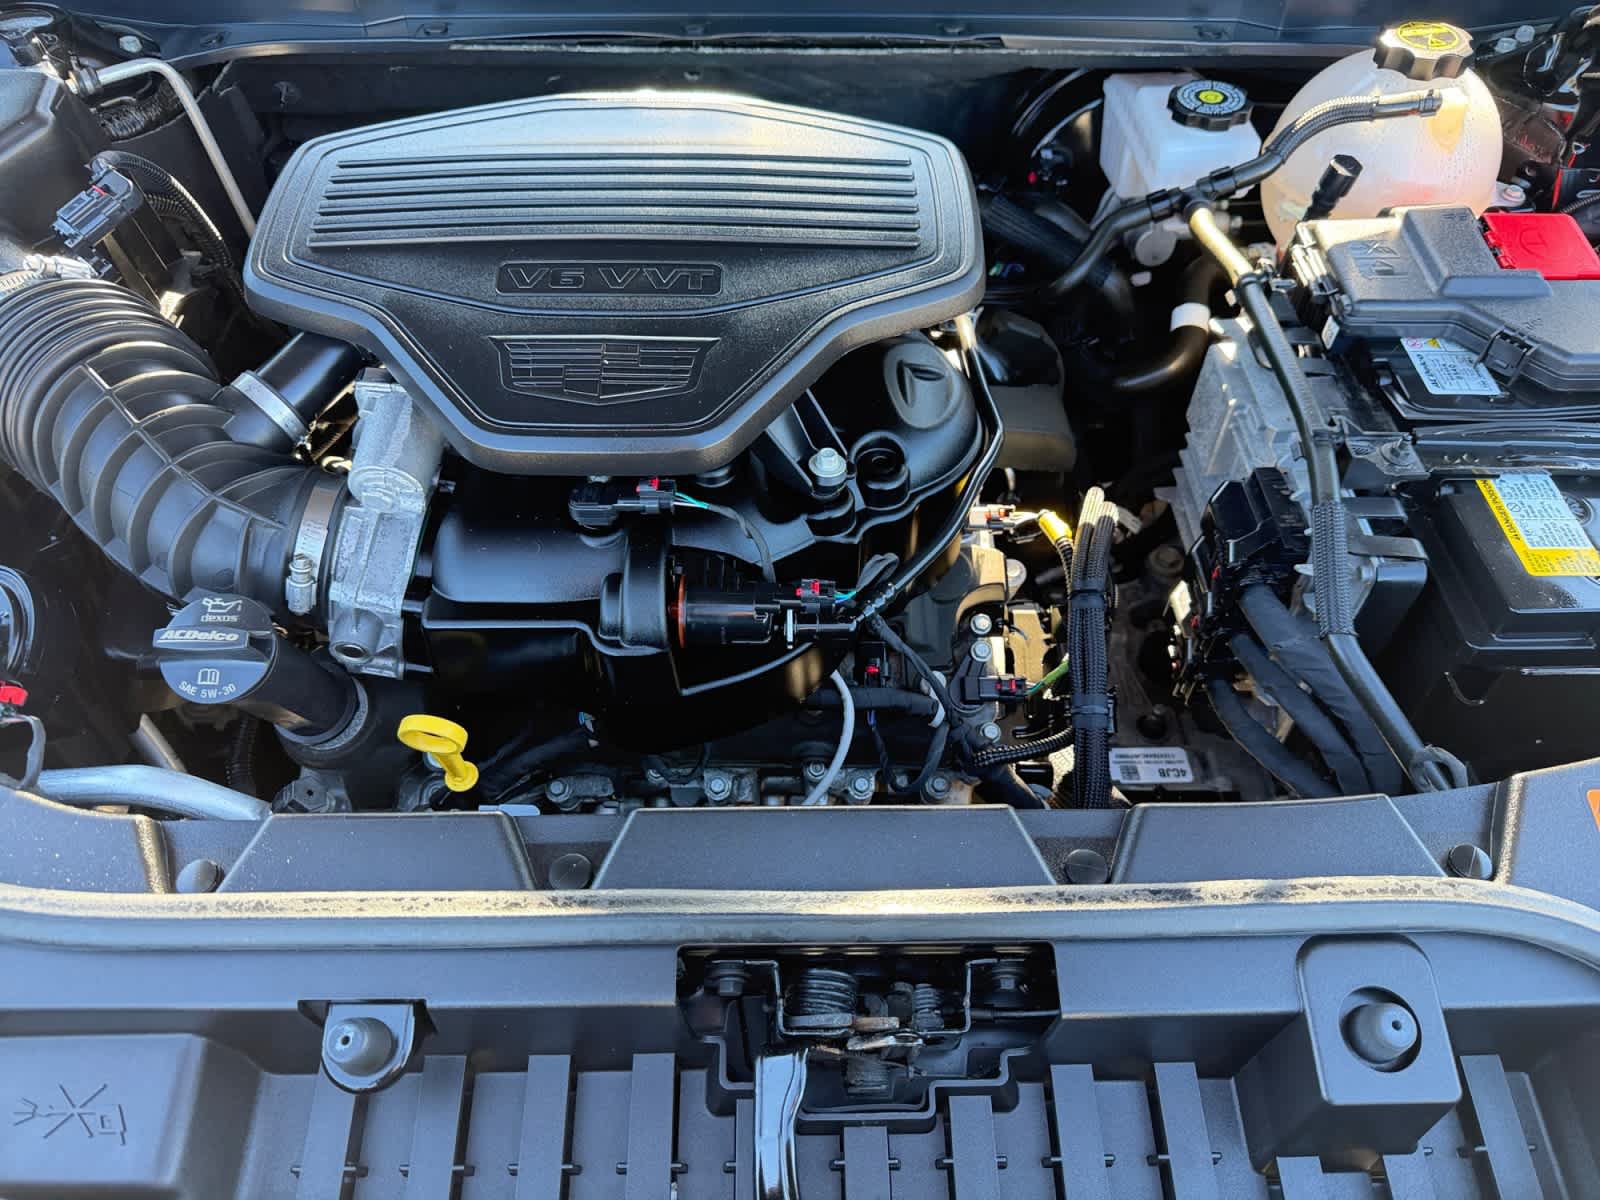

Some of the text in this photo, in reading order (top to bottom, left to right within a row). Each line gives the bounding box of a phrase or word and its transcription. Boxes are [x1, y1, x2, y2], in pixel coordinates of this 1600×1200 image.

[507, 267, 715, 290] V6 VVT
[200, 613, 238, 623] dexos
[159, 629, 240, 641] ACDelco
[178, 681, 236, 698] SAE 5W-30
[1158, 767, 1187, 778] 4CJB
